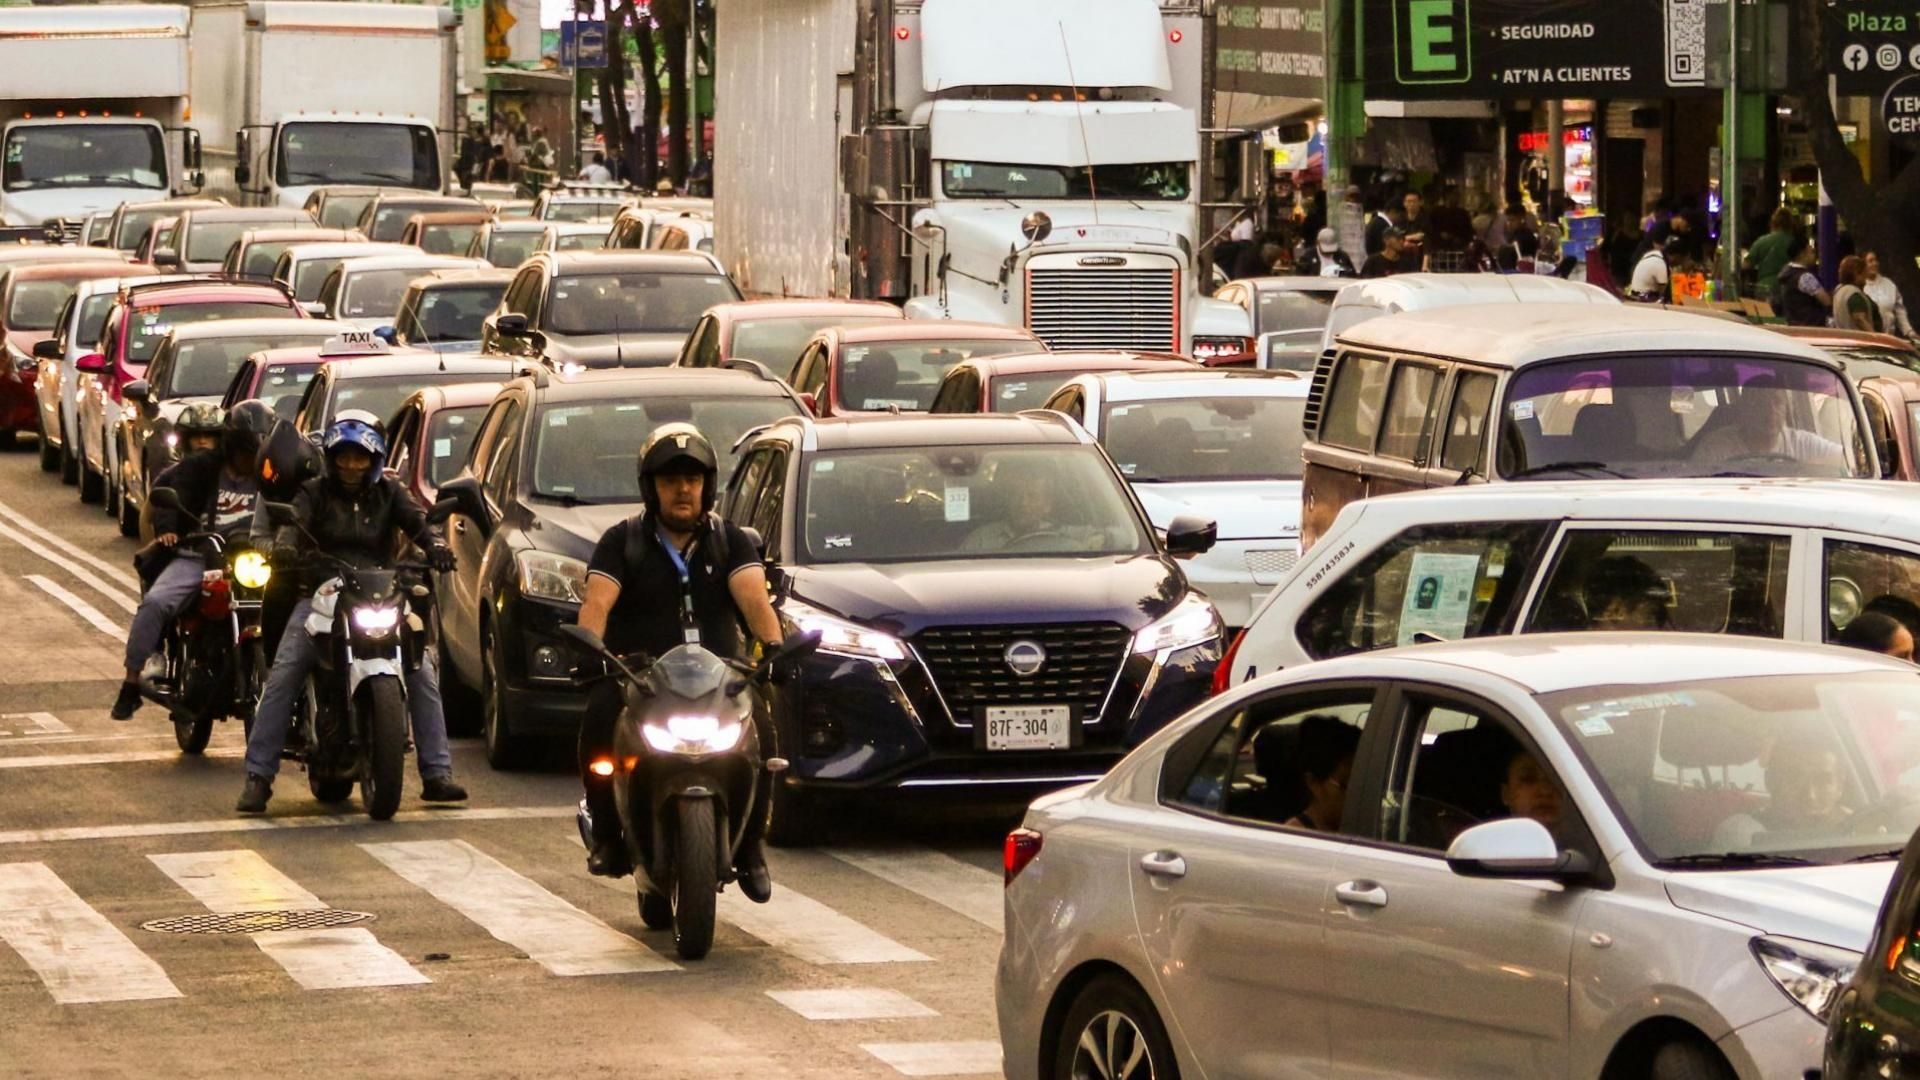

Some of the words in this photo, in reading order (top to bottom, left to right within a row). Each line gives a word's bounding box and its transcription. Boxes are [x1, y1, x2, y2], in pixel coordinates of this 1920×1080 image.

[1848, 12, 1906, 31] Plaza
[1410, 0, 1456, 71] E
[1501, 24, 1595, 40] SEGURIDAD
[1542, 69, 1554, 82] A
[1557, 67, 1631, 82] CLIENTES
[341, 332, 370, 344] TAXI
[989, 718, 1048, 737] 87F-304
